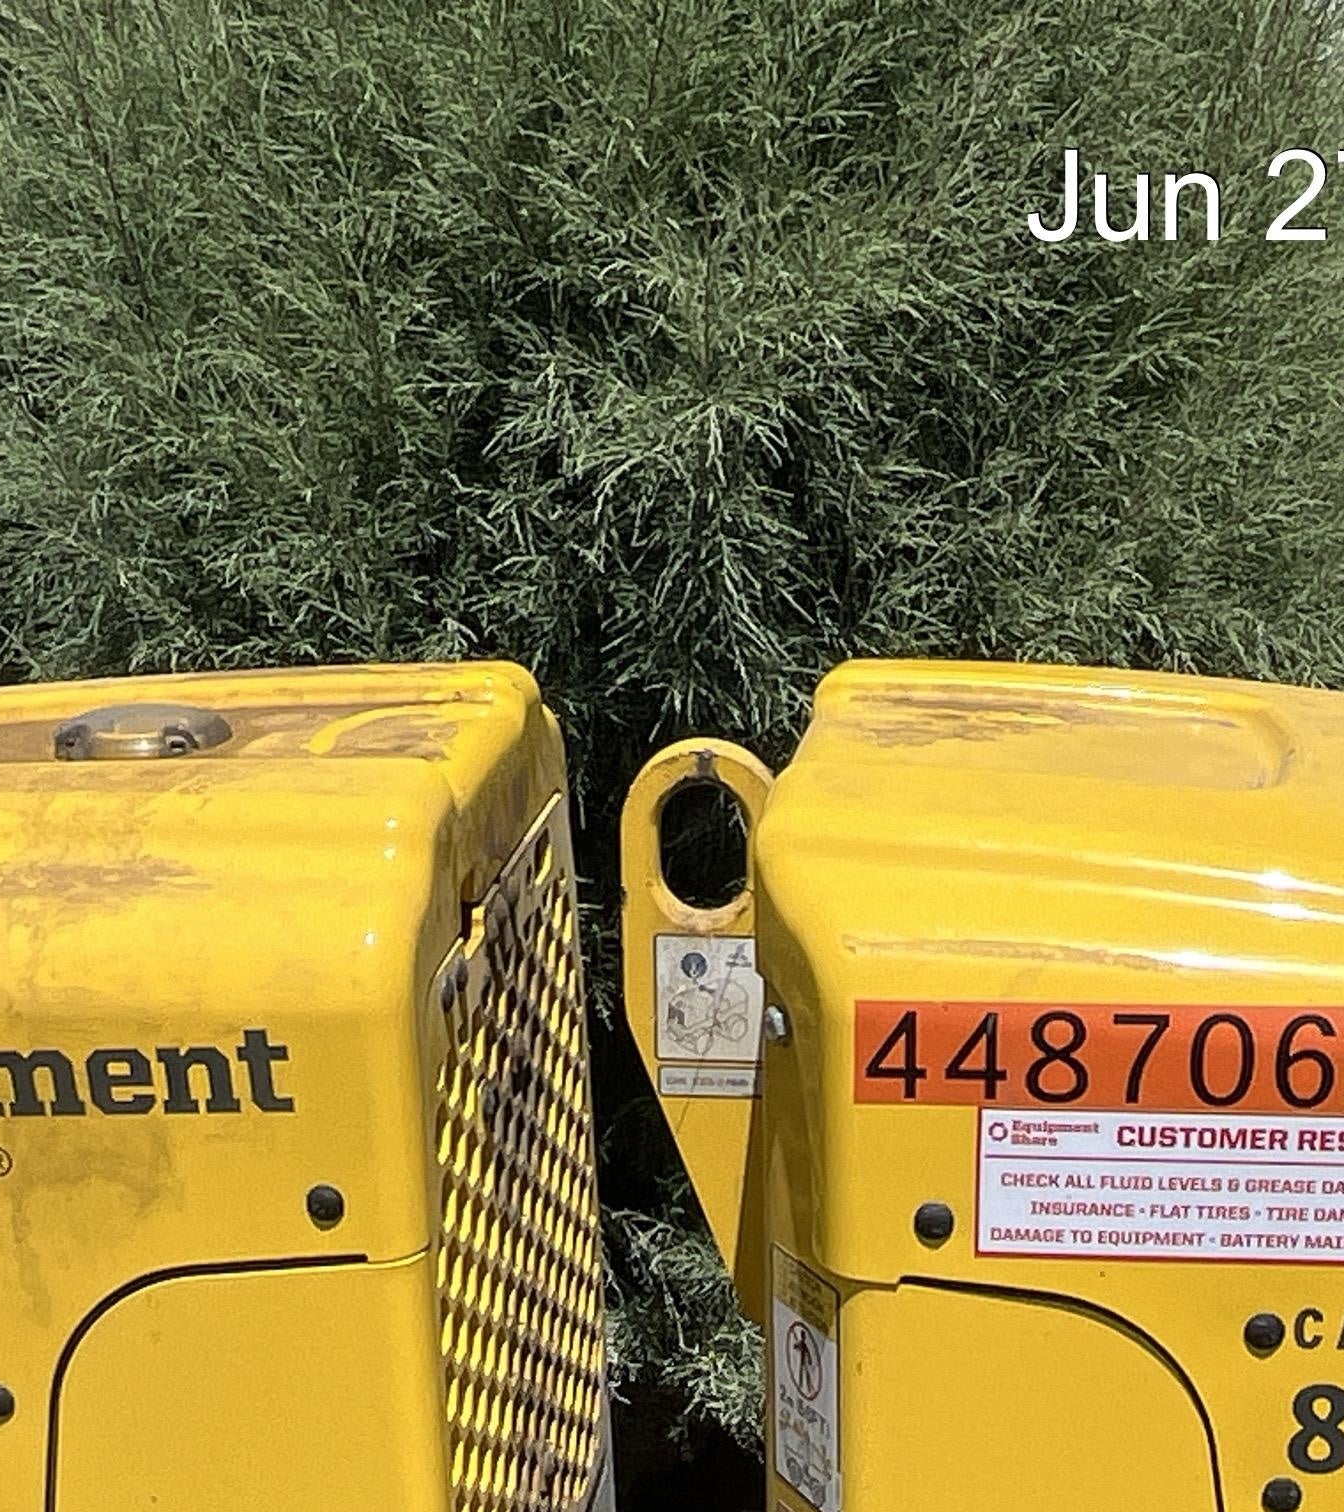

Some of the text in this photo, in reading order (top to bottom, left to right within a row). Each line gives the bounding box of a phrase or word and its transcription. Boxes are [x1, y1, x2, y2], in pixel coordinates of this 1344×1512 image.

[864, 1009, 1337, 1110] 448706
[1010, 1119, 1099, 1135] Equipment
[1116, 1125, 1289, 1151] CUSTOMER
[1000, 1172, 1060, 1189] CHECK
[1064, 1173, 1095, 1190] ALL
[1099, 1175, 1154, 1191] FLUID
[1157, 1176, 1223, 1193] LEVELS
[1244, 1177, 1317, 1195] GREASE
[1029, 1200, 1136, 1217] INSURANCE
[1148, 1203, 1192, 1219] FLAT
[1195, 1204, 1251, 1221] TIRES
[1265, 1206, 1310, 1222] TIRE
[989, 1227, 1066, 1244] DAMAGE
[1070, 1228, 1093, 1244] TO
[1097, 1230, 1205, 1248] EQUIPMENT
[1219, 1233, 1301, 1250] BATTERY
